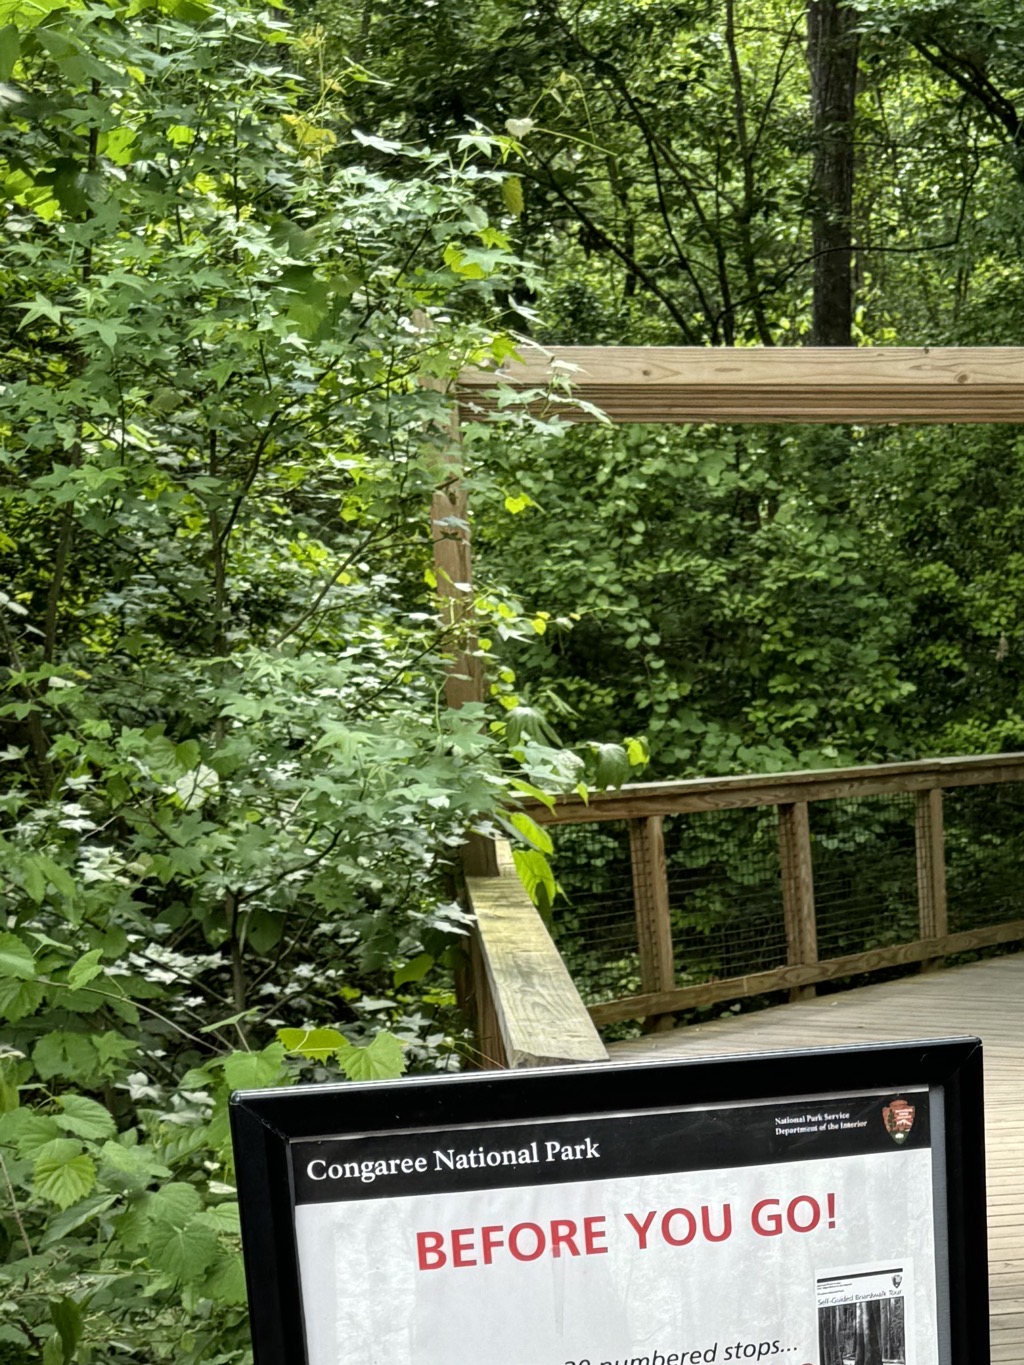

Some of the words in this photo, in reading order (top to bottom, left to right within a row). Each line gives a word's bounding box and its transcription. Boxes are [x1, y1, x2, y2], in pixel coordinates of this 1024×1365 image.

[775, 1115, 805, 1125] National
[806, 1113, 822, 1122] Park
[824, 1112, 850, 1120] Service
[775, 1125, 818, 1136] Department
[819, 1123, 827, 1131] of
[828, 1122, 839, 1130] the
[840, 1120, 868, 1129] Interior
[307, 1157, 427, 1183] Congaree
[433, 1142, 539, 1170] National
[545, 1138, 600, 1161] Park
[417, 1216, 608, 1270] BEFORE
[624, 1204, 732, 1249] YOU
[751, 1193, 835, 1236] GO!
[724, 1340, 797, 1361] stops...
